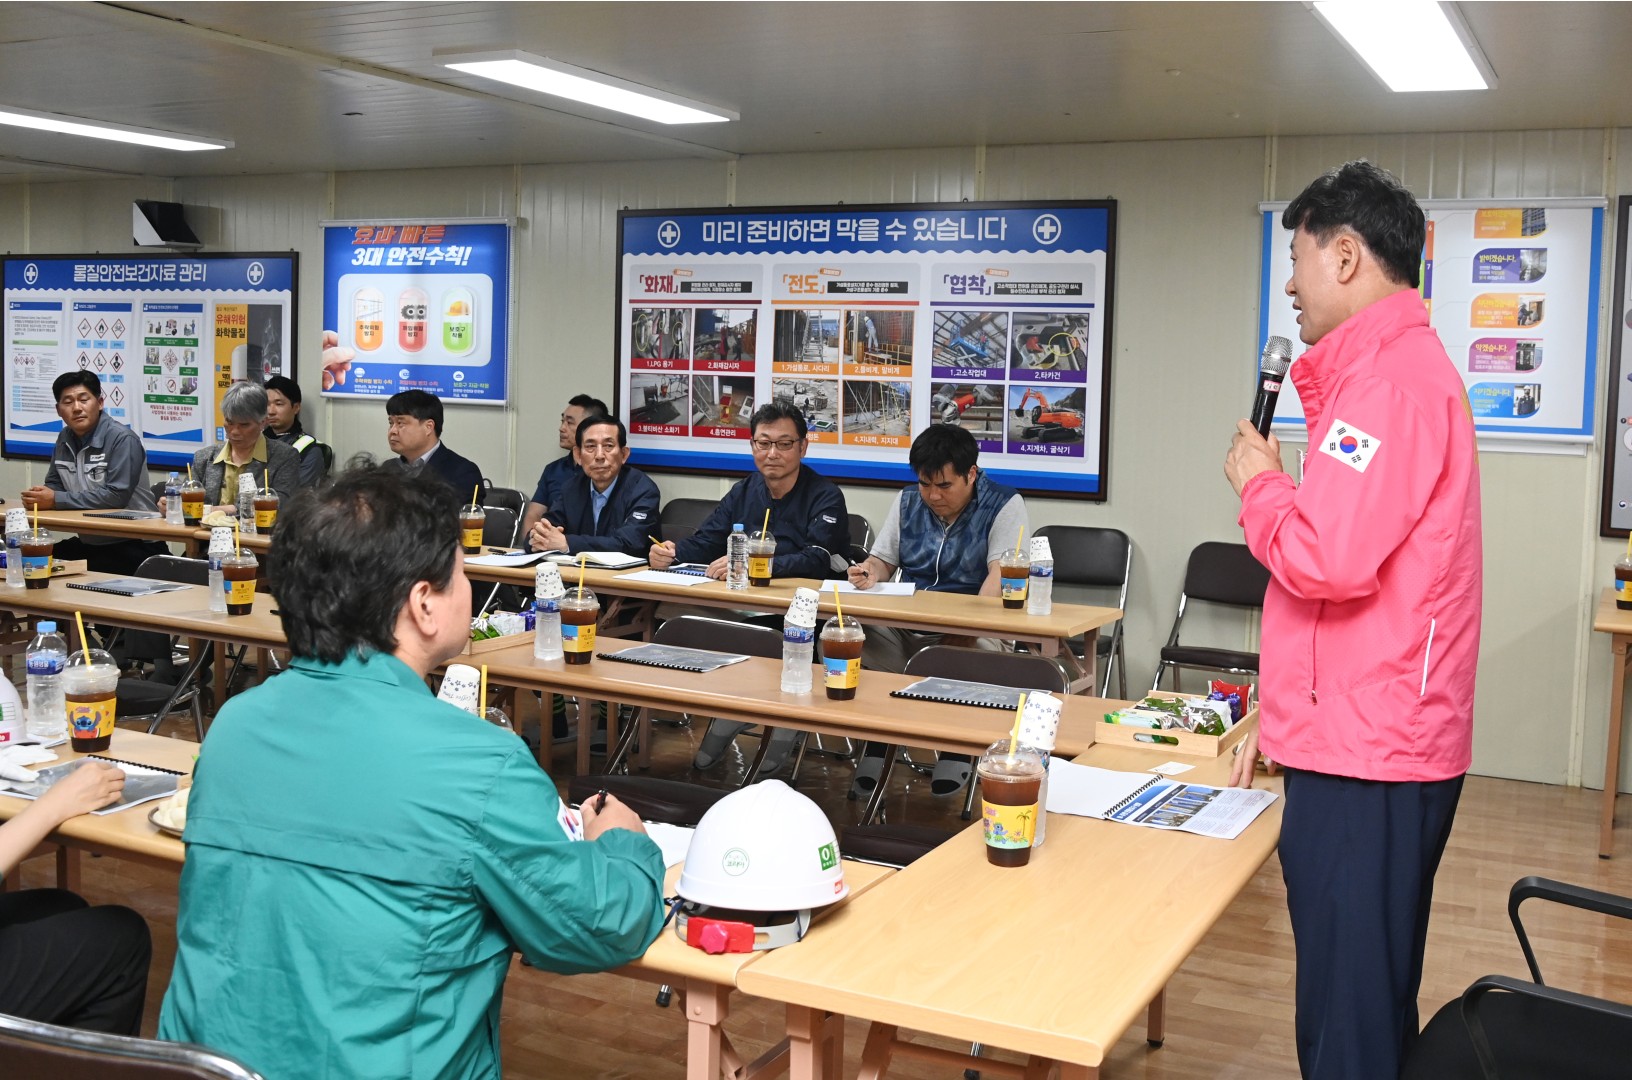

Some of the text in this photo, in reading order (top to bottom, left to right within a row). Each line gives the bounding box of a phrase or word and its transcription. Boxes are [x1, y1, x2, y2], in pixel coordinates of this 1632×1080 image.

[702, 216, 1008, 244] 미리 준비하면 막을 수 있습니다
[352, 246, 472, 266] 3대 안전수칙!
[74, 263, 207, 283] 물질안전보건자료 관리
[216, 314, 246, 324] 유해위험
[216, 327, 246, 338] 화학물질
[1476, 344, 1508, 352] 막겠습니다.
[708, 362, 740, 370] 2.화재감시자
[812, 364, 830, 372] 사다리
[950, 370, 987, 378] 1.고소작업대
[1034, 371, 1061, 380] 2.타카건
[664, 426, 680, 434] 소화기
[1020, 444, 1070, 454] 4.지게차, 굴삭기
